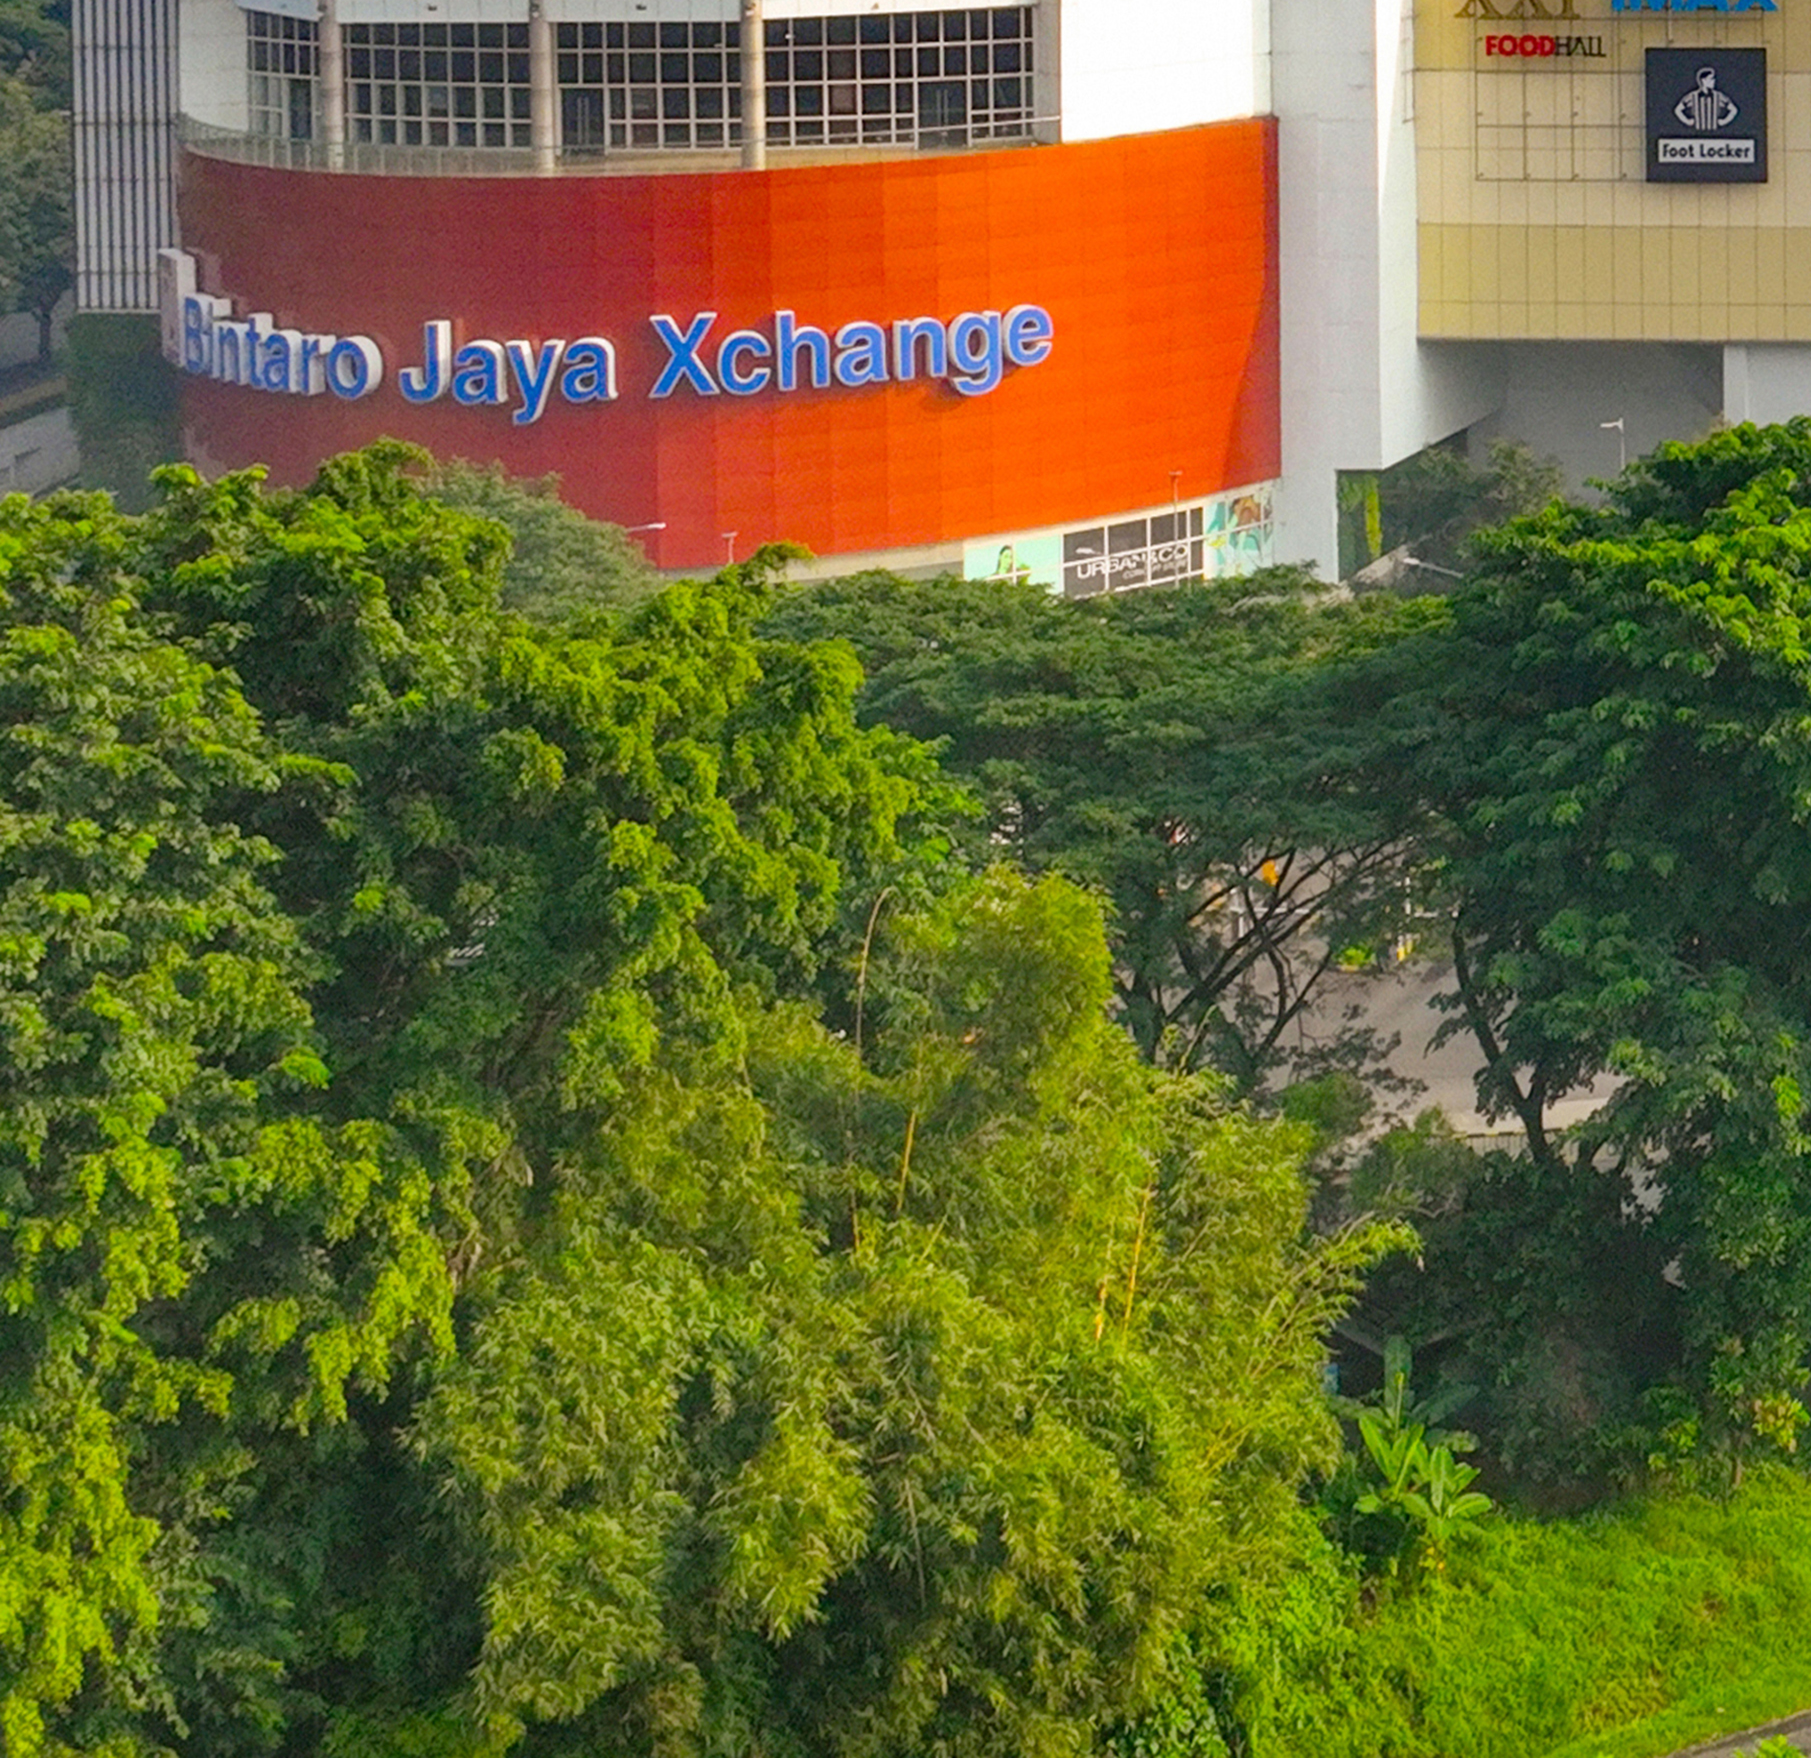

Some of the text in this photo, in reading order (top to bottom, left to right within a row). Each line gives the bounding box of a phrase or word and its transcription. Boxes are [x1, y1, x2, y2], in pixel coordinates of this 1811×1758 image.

[1662, 142, 1751, 160] Foot Locker
[182, 293, 1054, 426] Bintaro Jaya Xchange
